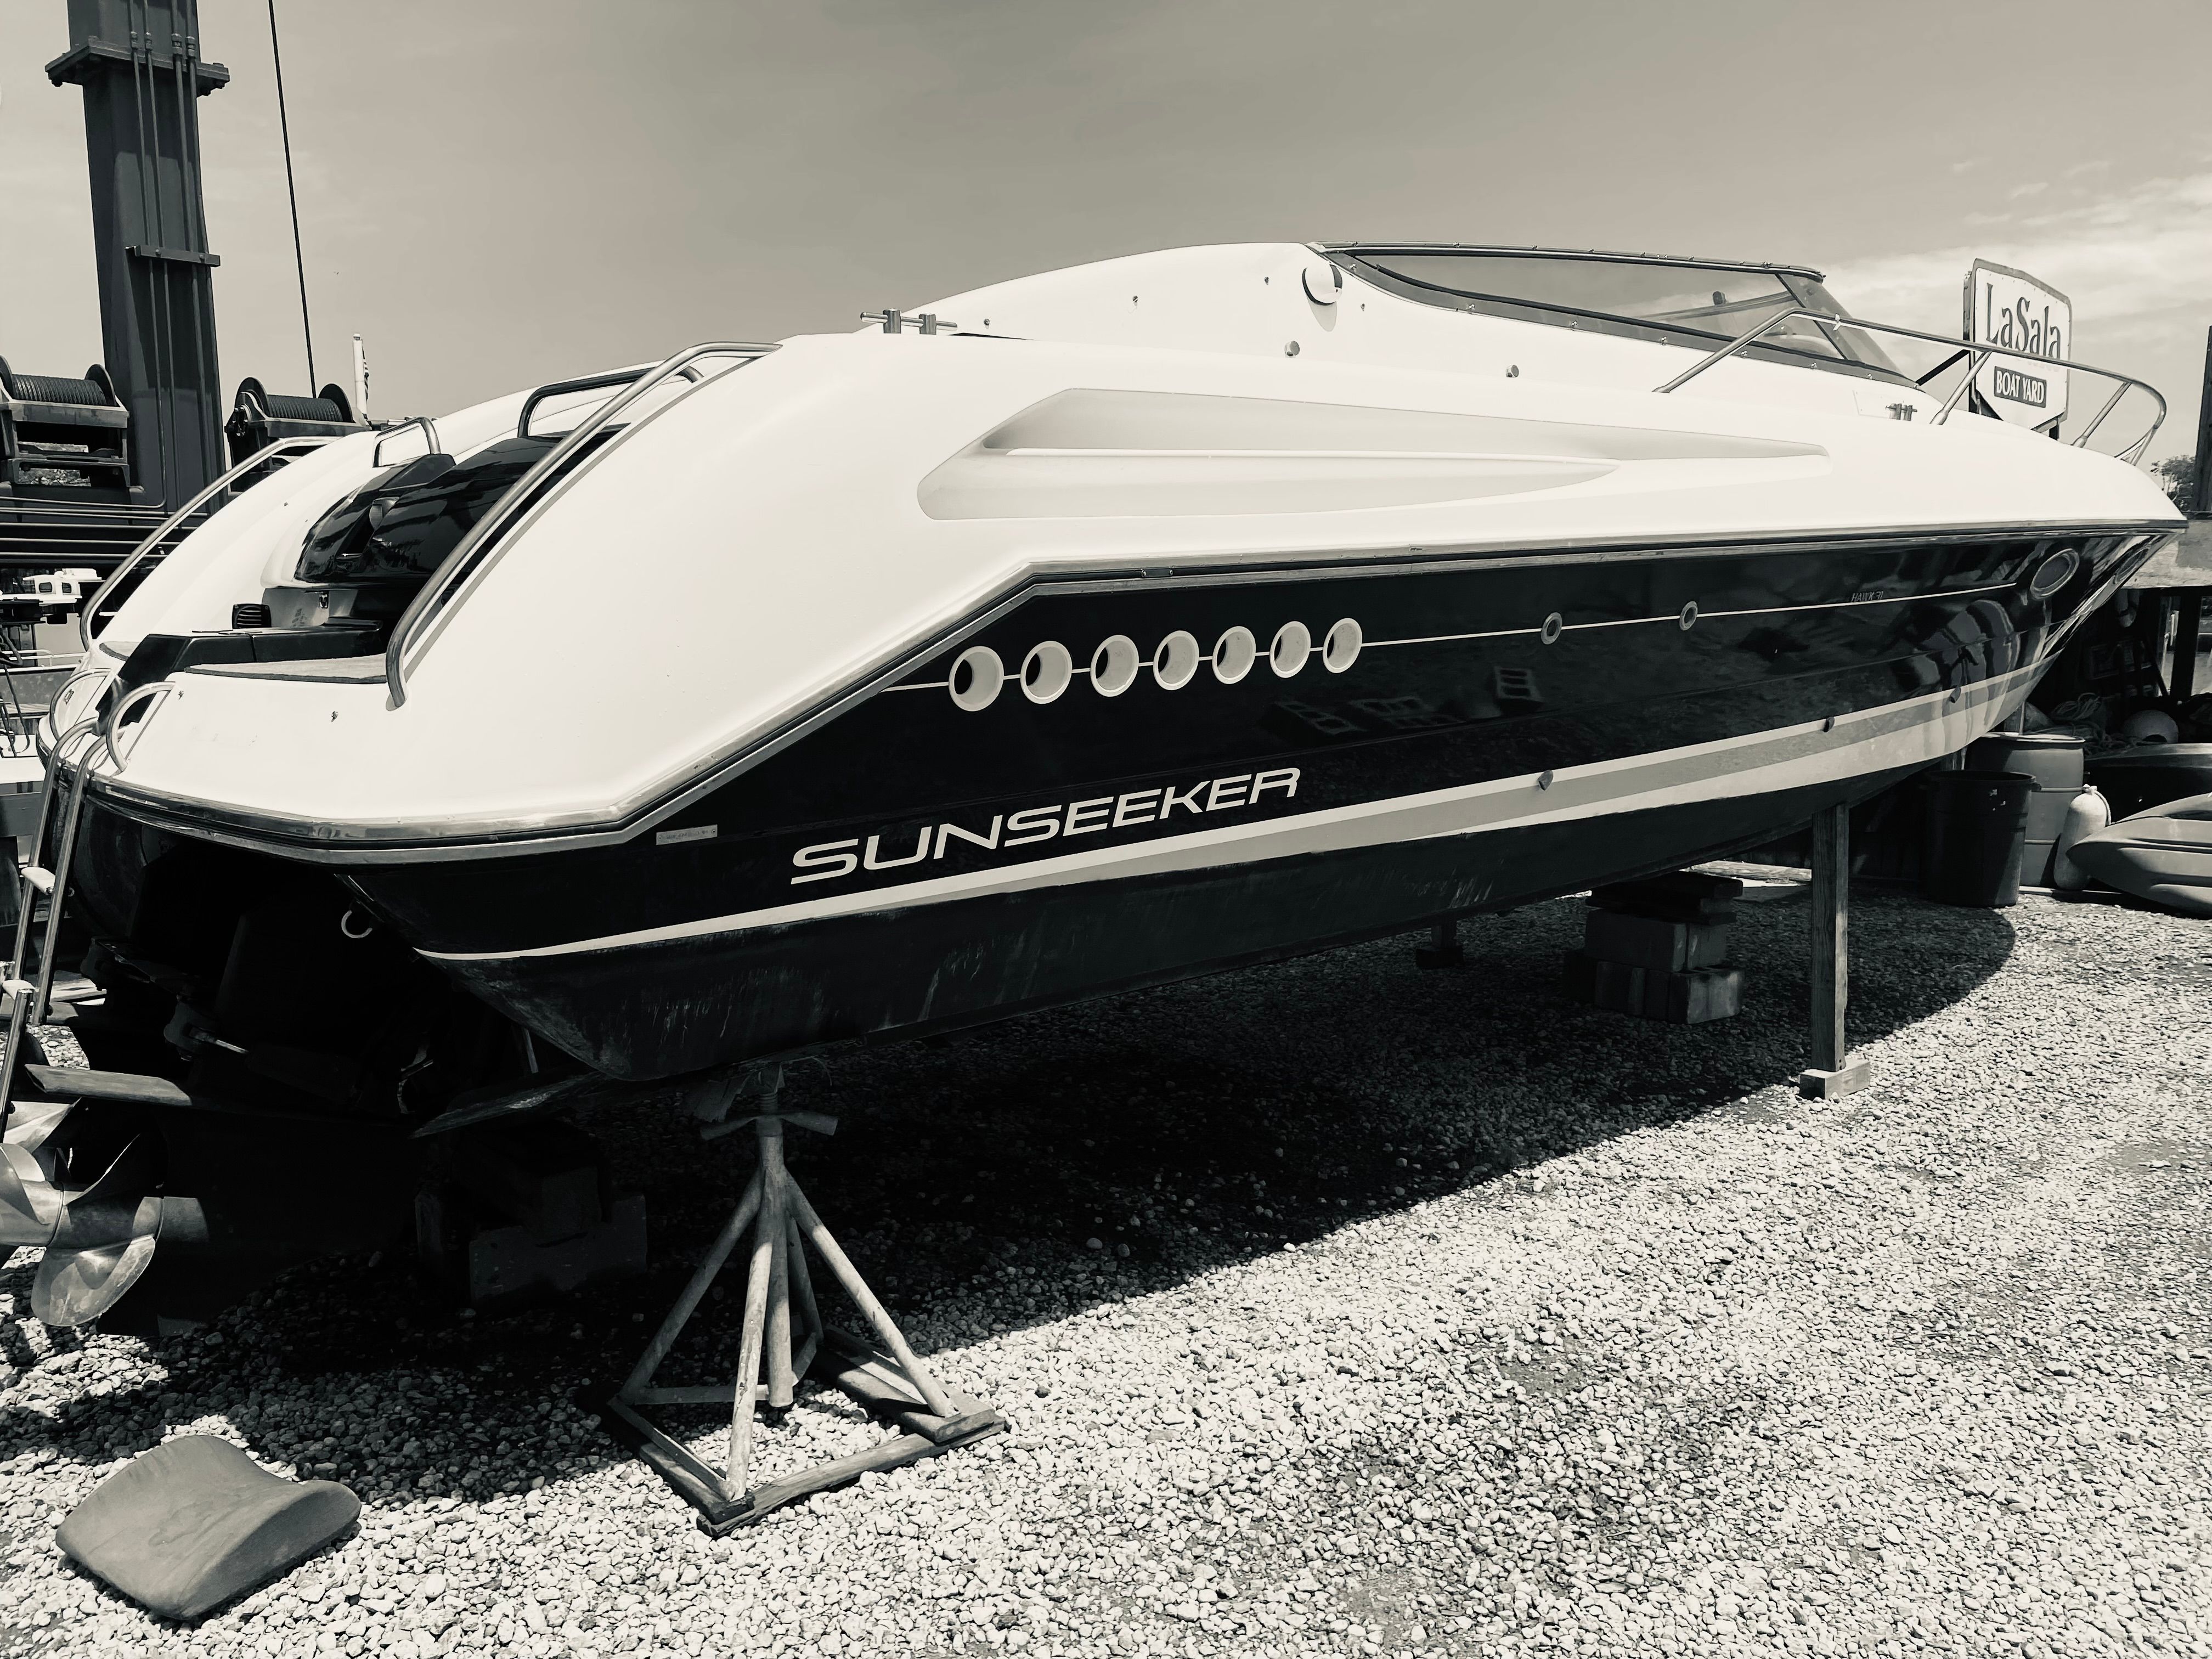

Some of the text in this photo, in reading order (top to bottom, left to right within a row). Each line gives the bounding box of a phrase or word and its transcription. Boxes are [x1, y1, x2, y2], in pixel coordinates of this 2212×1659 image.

[1986, 283, 2061, 360] LaSala
[1996, 370, 2045, 404] BOAT YARD
[1851, 591, 1875, 602] HAWK
[791, 767, 1301, 884] SUNSEEKER
